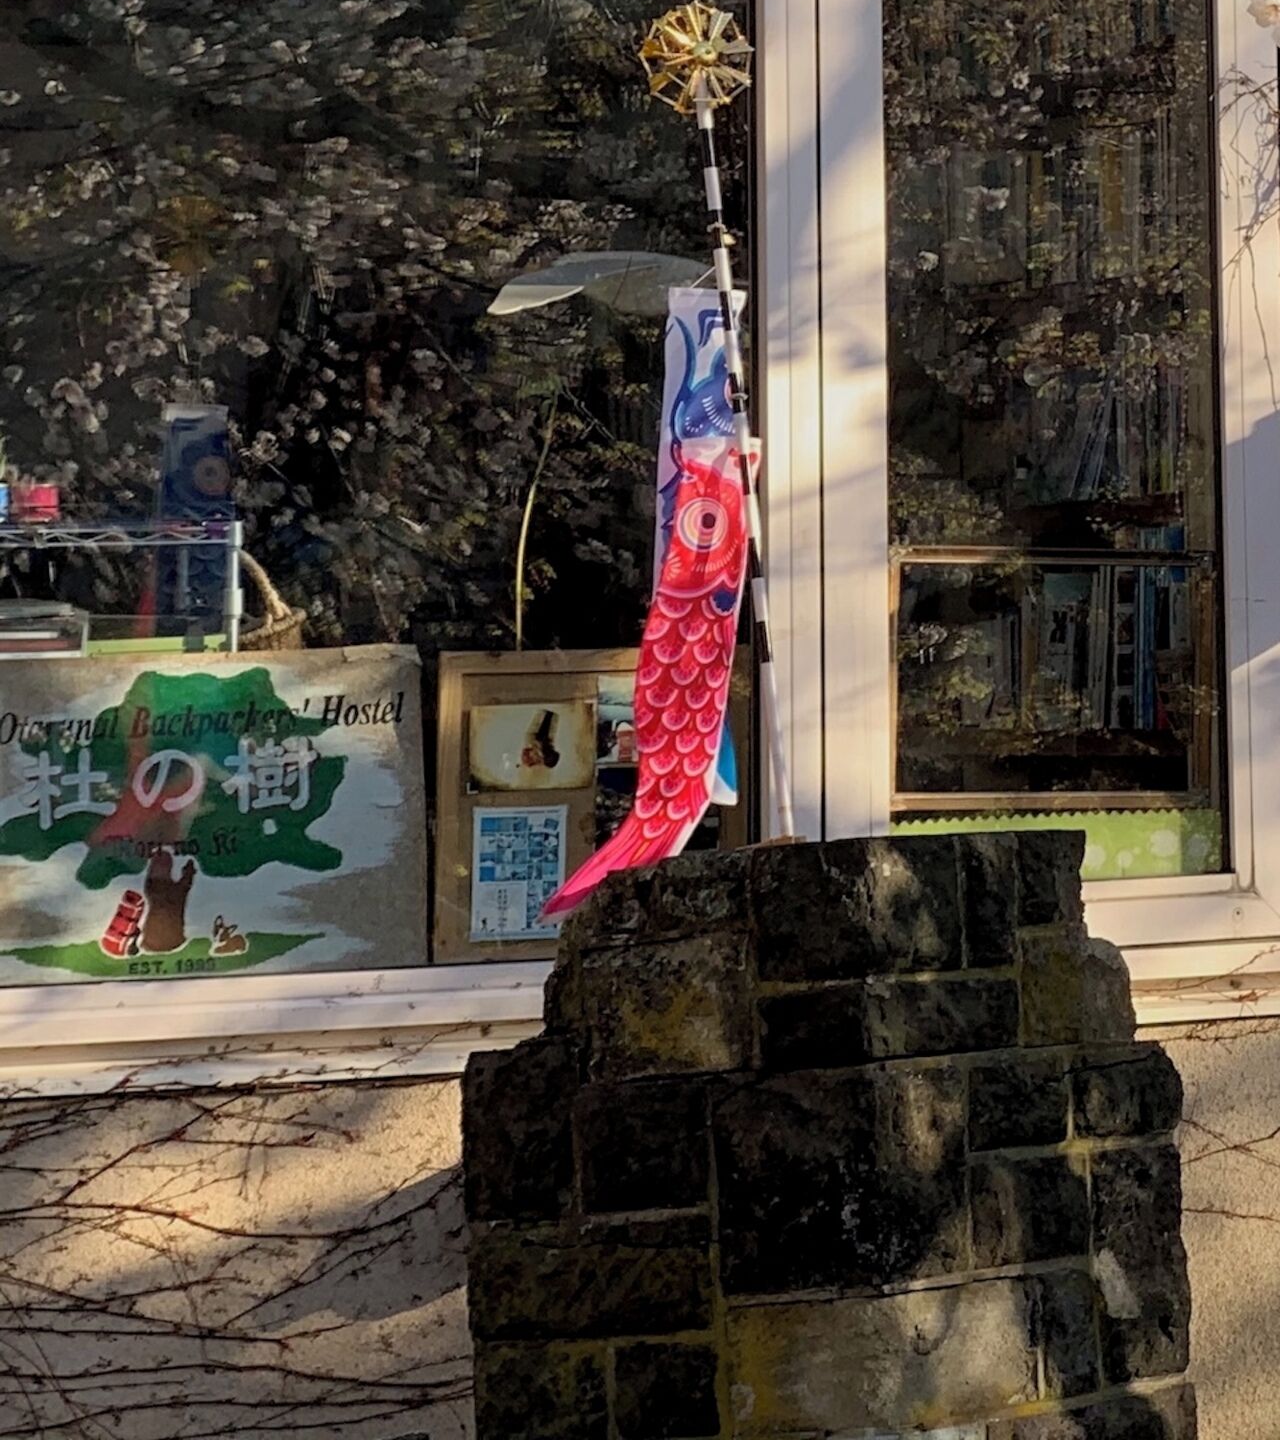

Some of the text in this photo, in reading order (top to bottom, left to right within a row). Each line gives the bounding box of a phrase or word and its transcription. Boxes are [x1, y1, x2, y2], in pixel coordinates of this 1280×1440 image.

[322, 691, 404, 727] Hostel
[22, 734, 322, 831] 杜の樹
[129, 961, 167, 975] EST.
